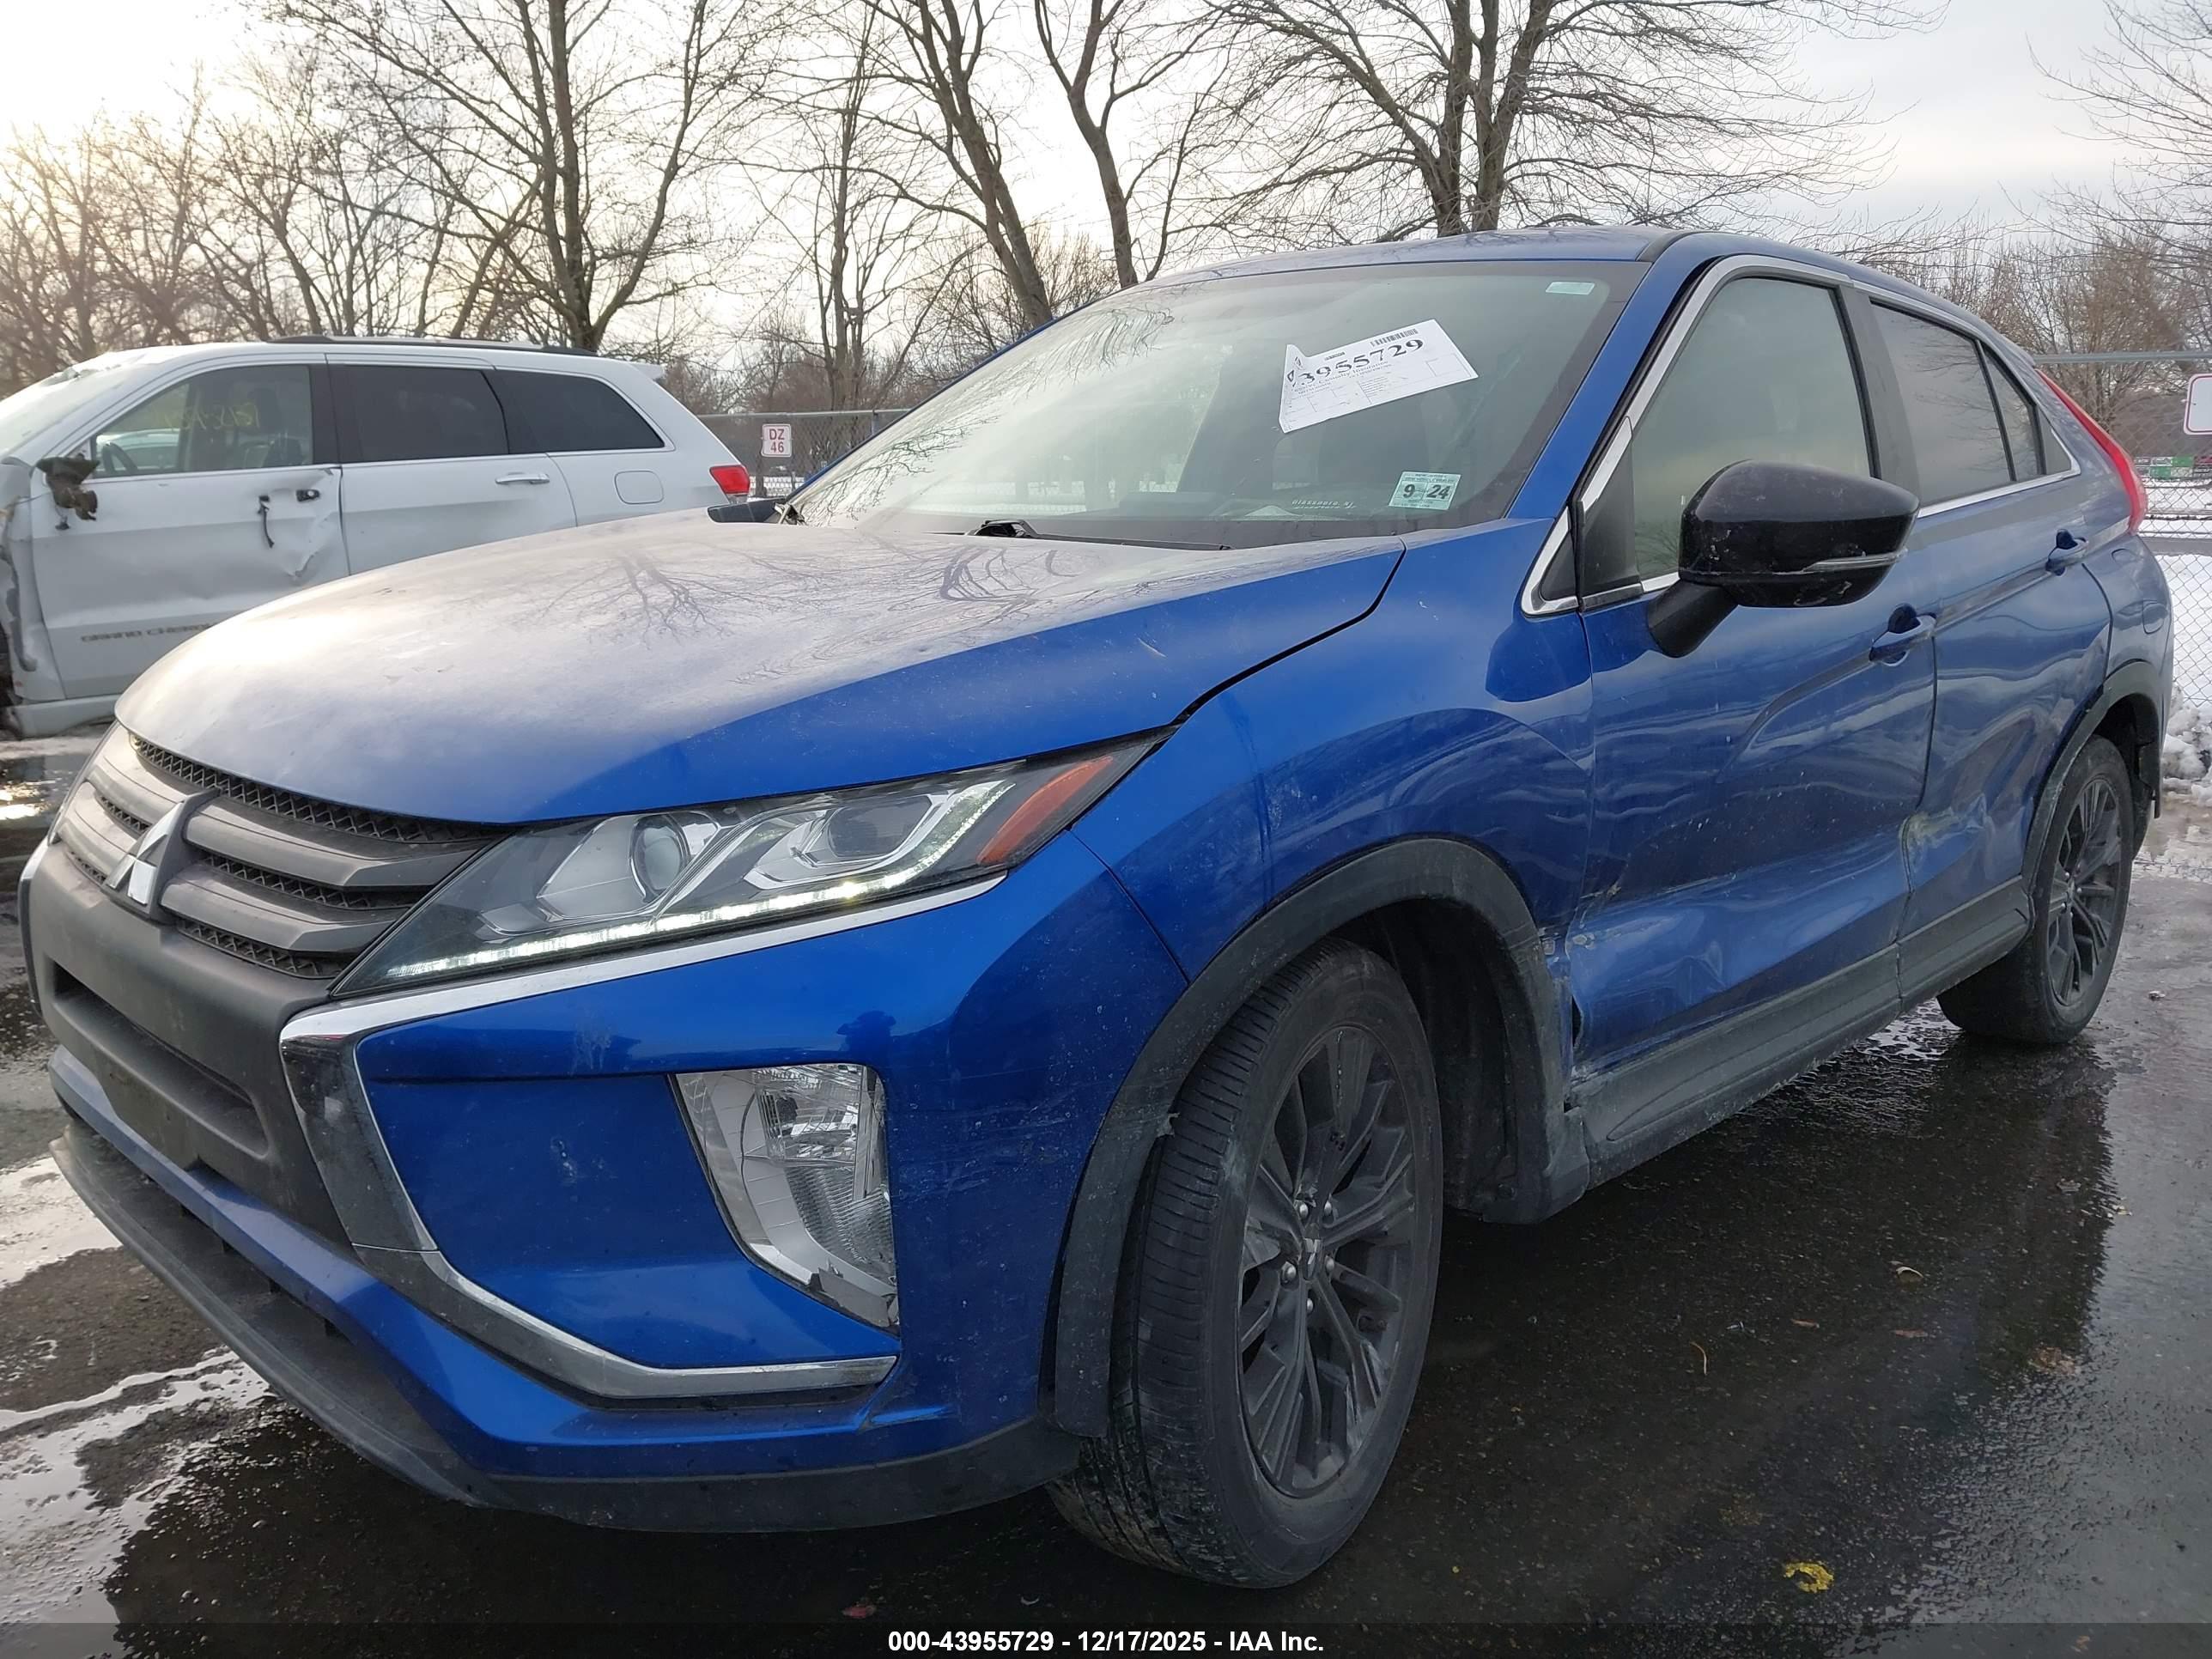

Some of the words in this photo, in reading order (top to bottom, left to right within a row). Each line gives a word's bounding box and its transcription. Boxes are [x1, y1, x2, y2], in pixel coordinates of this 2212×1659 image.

[769, 428, 785, 440] DZ
[770, 441, 784, 453] 46
[1402, 483, 1415, 498] 9
[1426, 484, 1451, 500] 24
